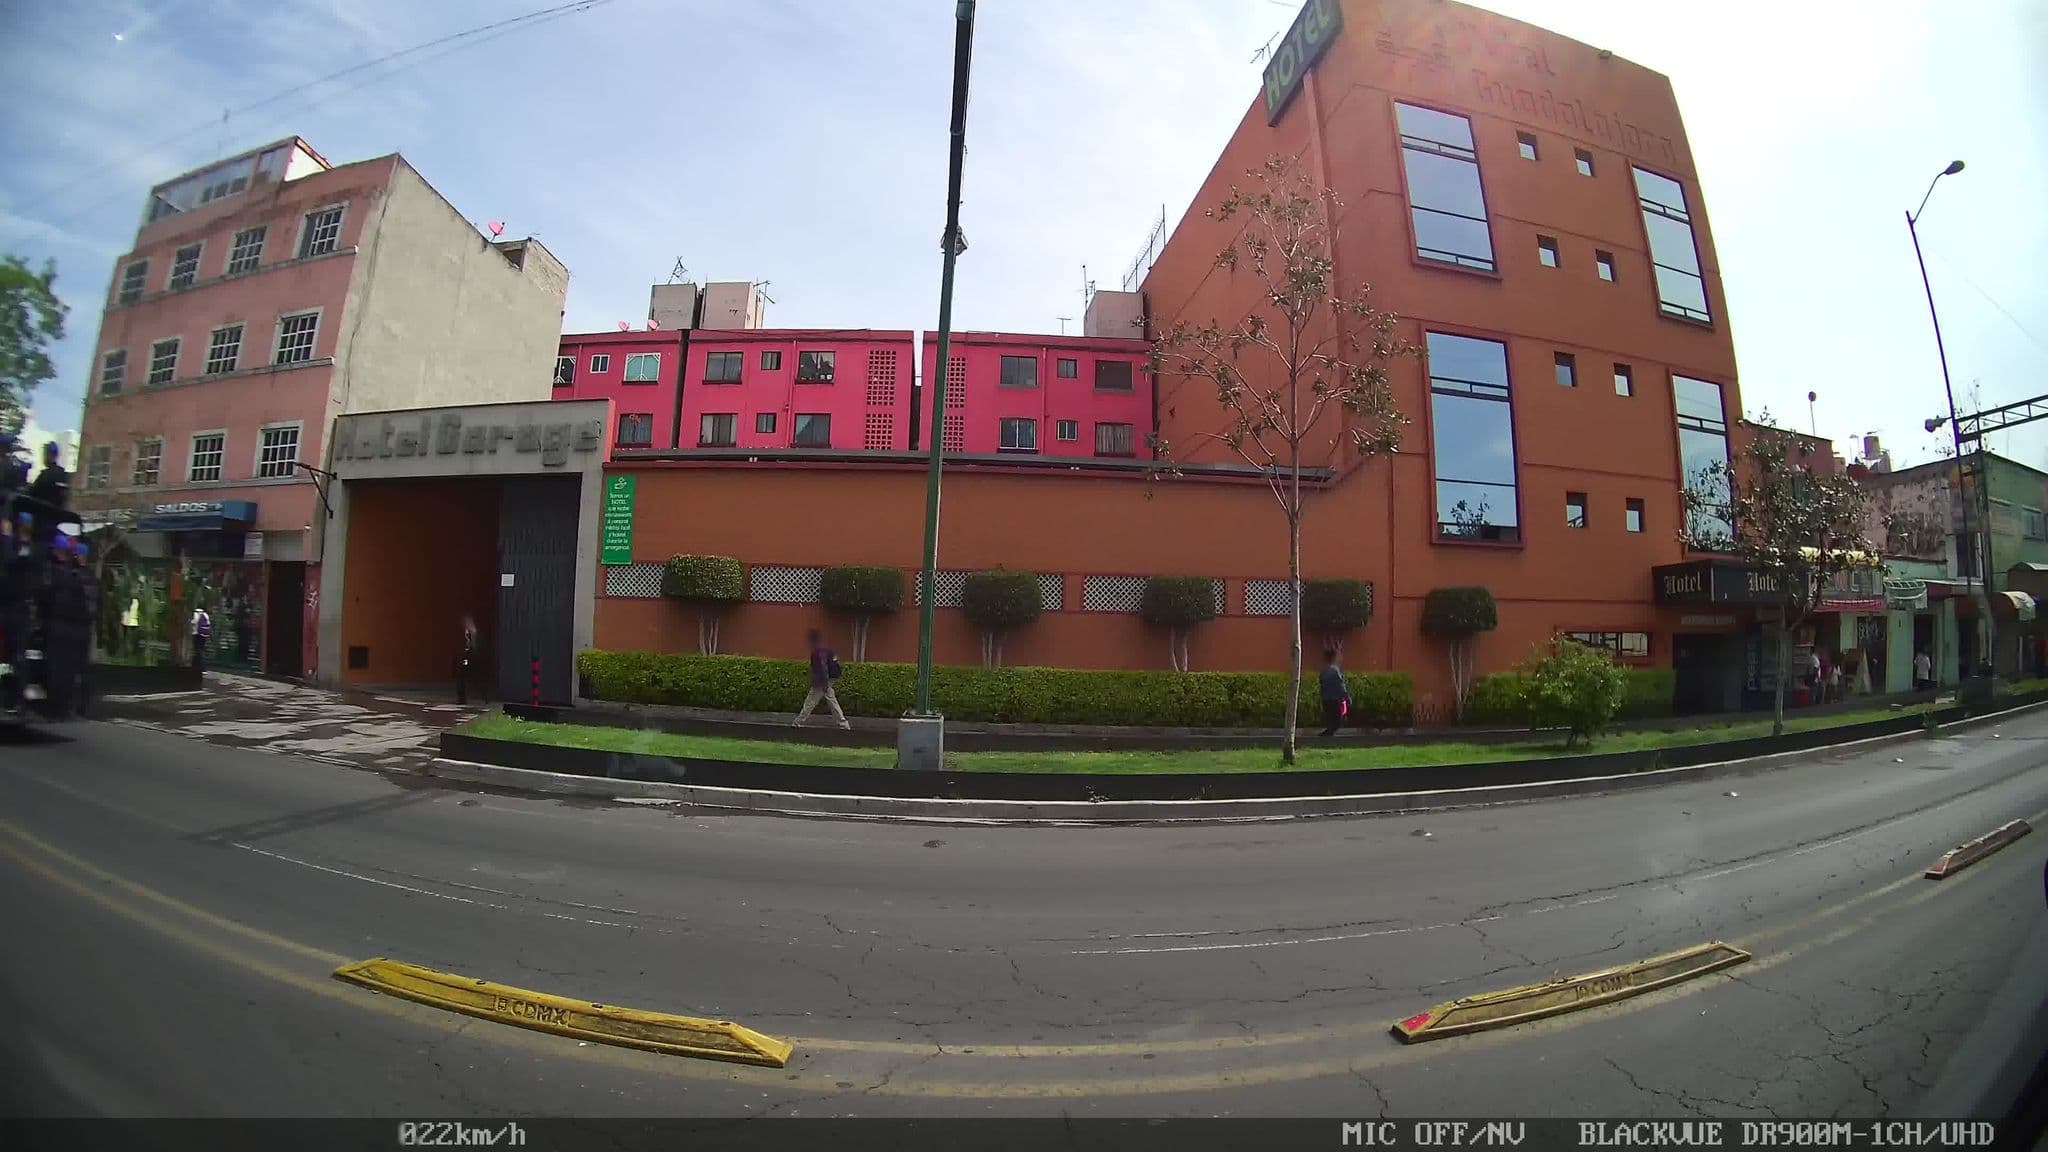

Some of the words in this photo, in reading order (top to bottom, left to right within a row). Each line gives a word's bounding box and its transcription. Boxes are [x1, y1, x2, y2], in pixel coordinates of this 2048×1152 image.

[1267, 0, 1331, 111] HOTEL
[155, 502, 208, 514] SALDOS
[1664, 571, 1702, 595] Hotel
[510, 1000, 570, 1027] CDMX
